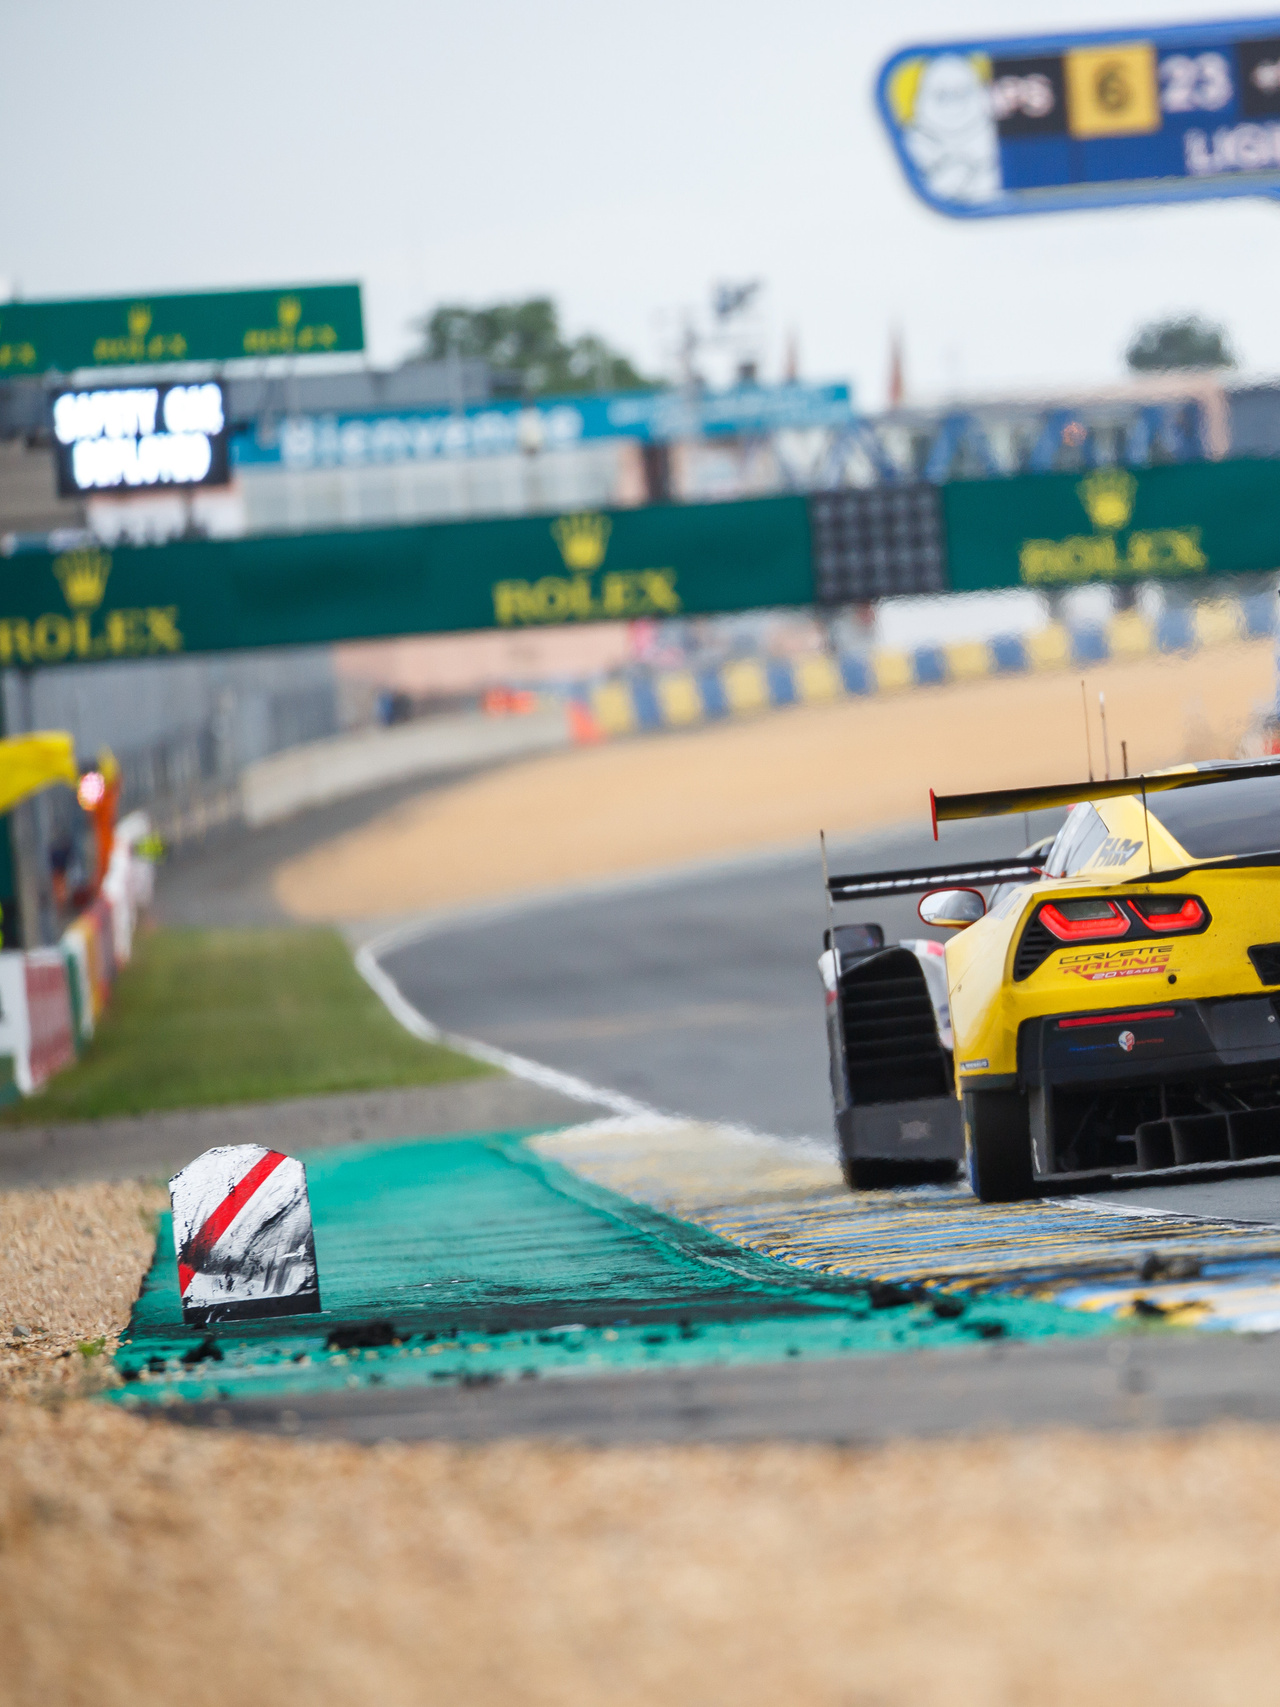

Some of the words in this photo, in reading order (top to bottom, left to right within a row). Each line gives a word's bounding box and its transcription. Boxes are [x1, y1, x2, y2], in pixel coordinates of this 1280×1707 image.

[1158, 52, 1233, 113] 23
[1017, 525, 1208, 584] ROLEX
[492, 568, 681, 627] ROLEX
[0, 605, 183, 667] ROLEX
[1057, 954, 1170, 974] RACING
[1059, 945, 1174, 964] CORVETTE
[1092, 971, 1117, 980] 20
[1119, 966, 1159, 976] YEARS
